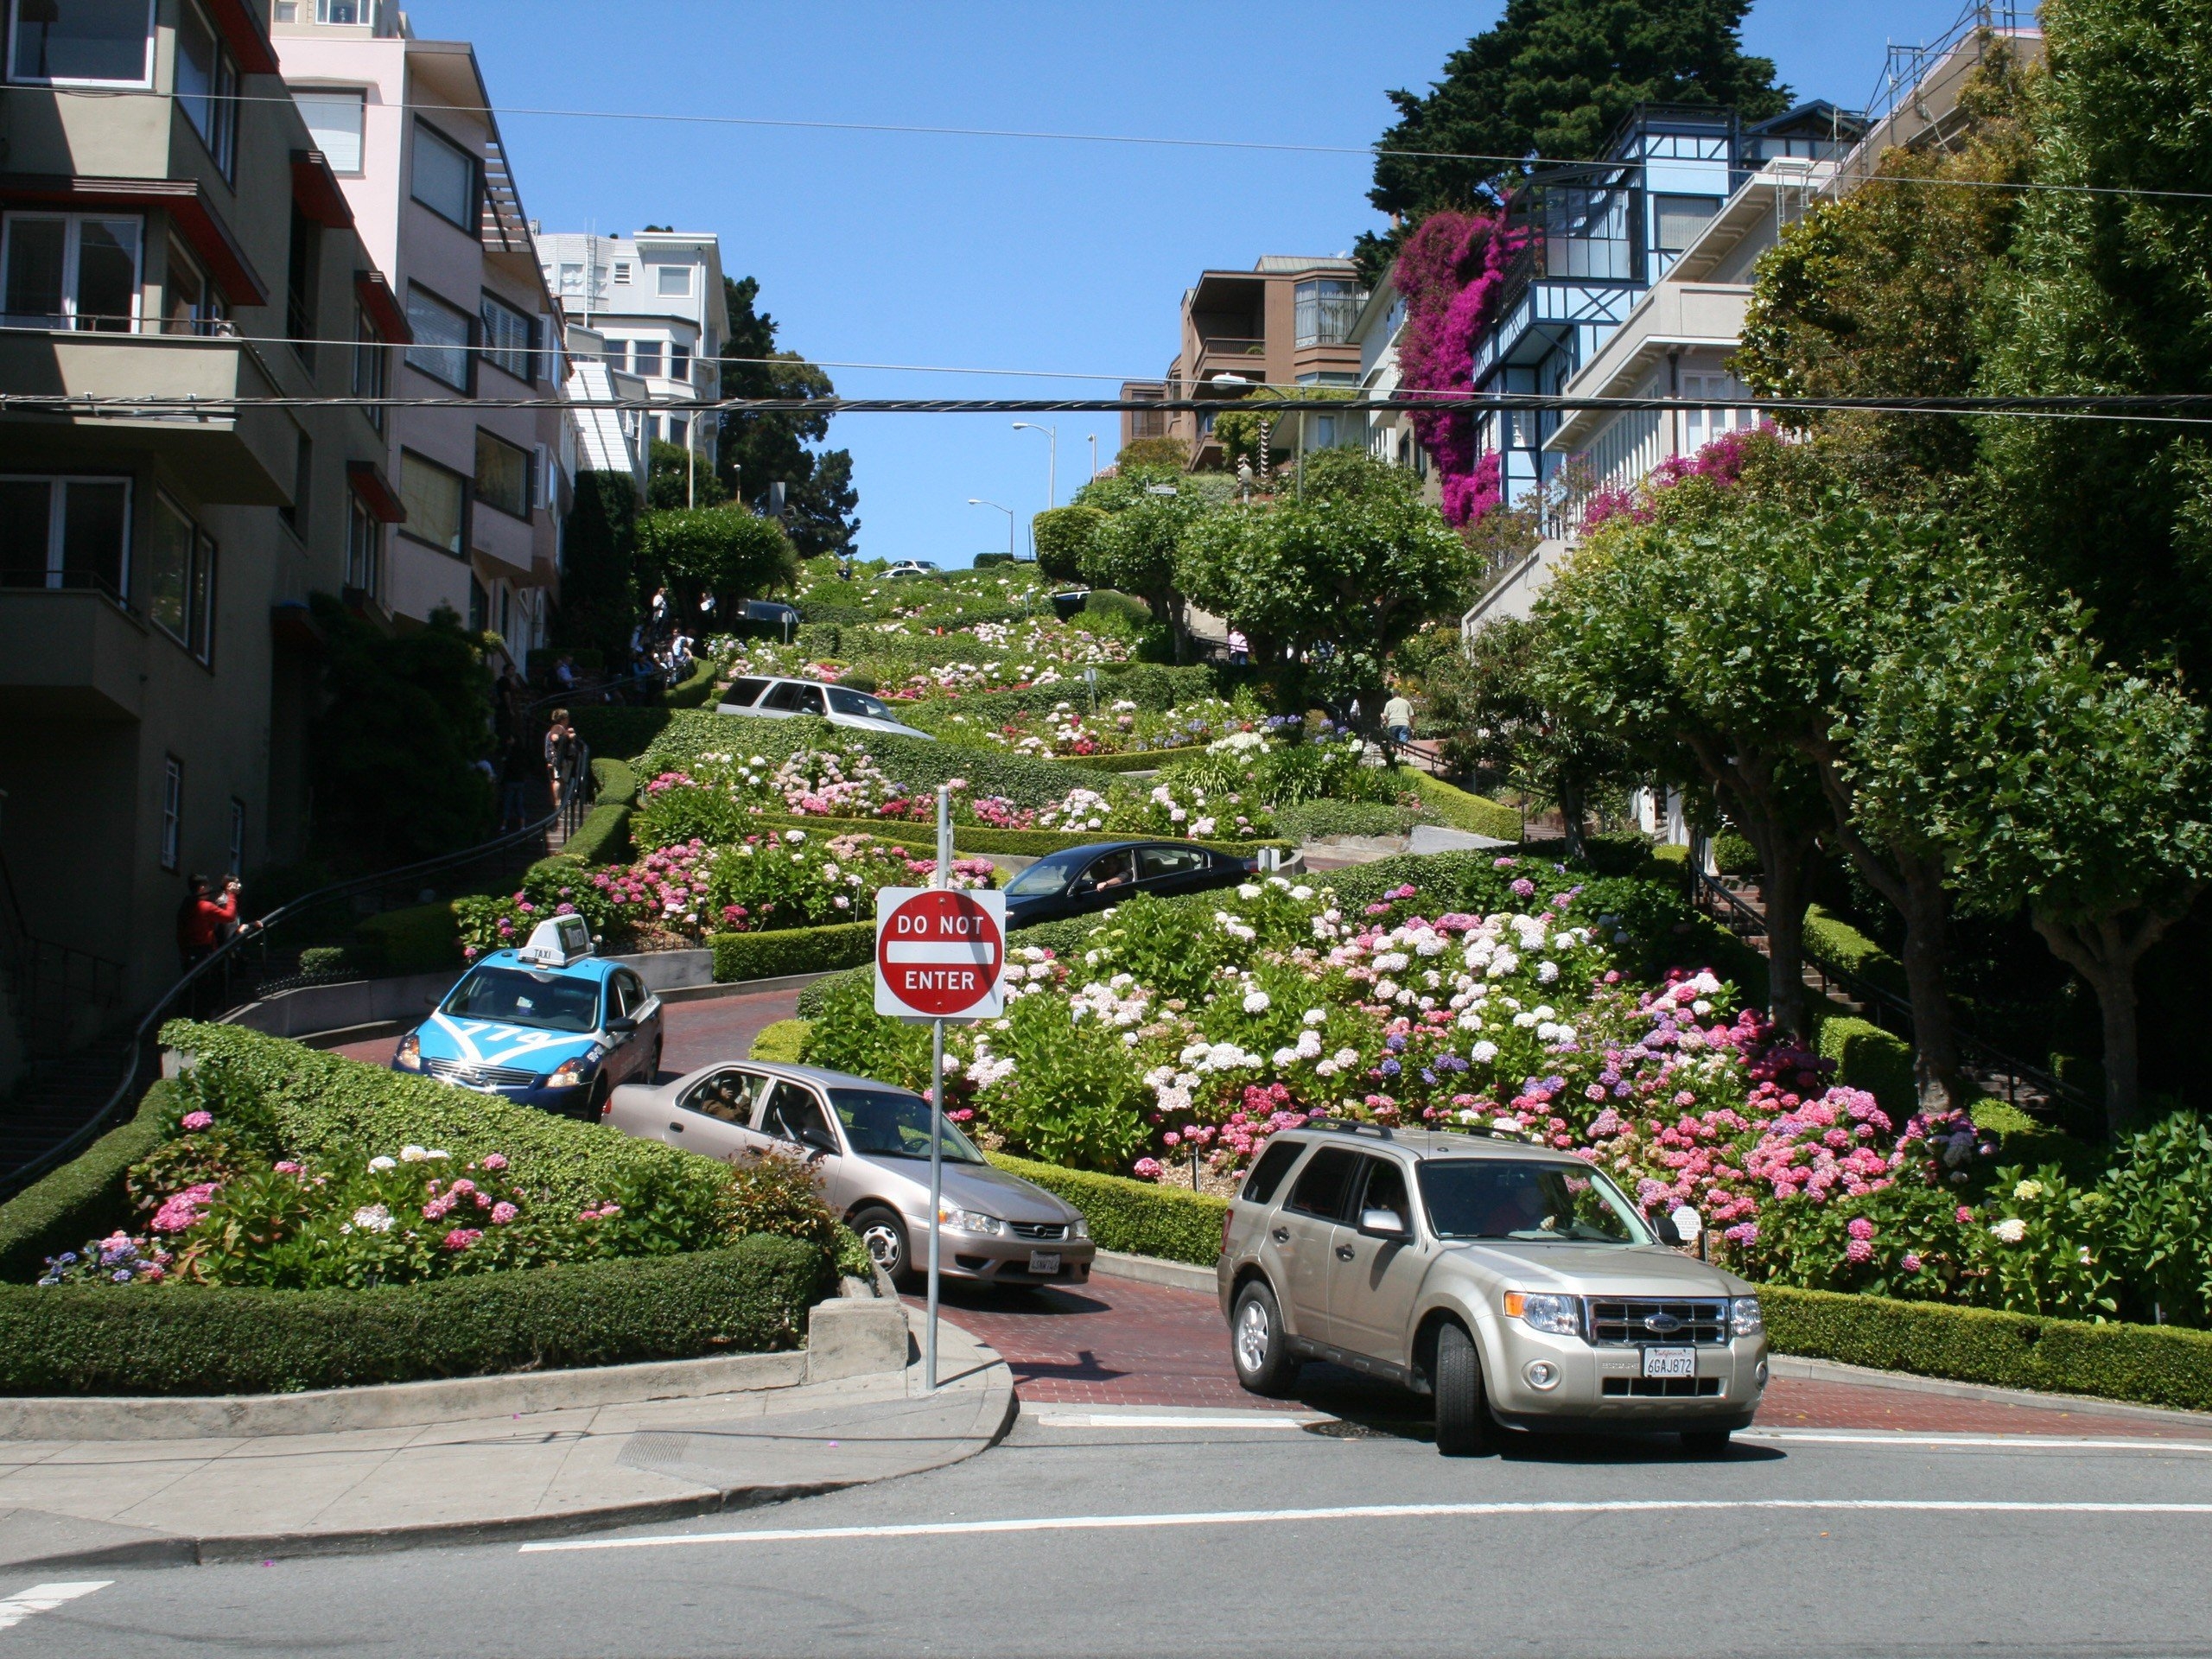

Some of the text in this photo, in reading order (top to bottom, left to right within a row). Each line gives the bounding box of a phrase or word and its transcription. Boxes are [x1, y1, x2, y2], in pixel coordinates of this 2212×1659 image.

[897, 915, 984, 935] DO NOT
[534, 949, 551, 959] TAXI
[905, 970, 975, 990] ENTER
[462, 1021, 553, 1046] 774
[1648, 1358, 1692, 1373] 6GAJ872
